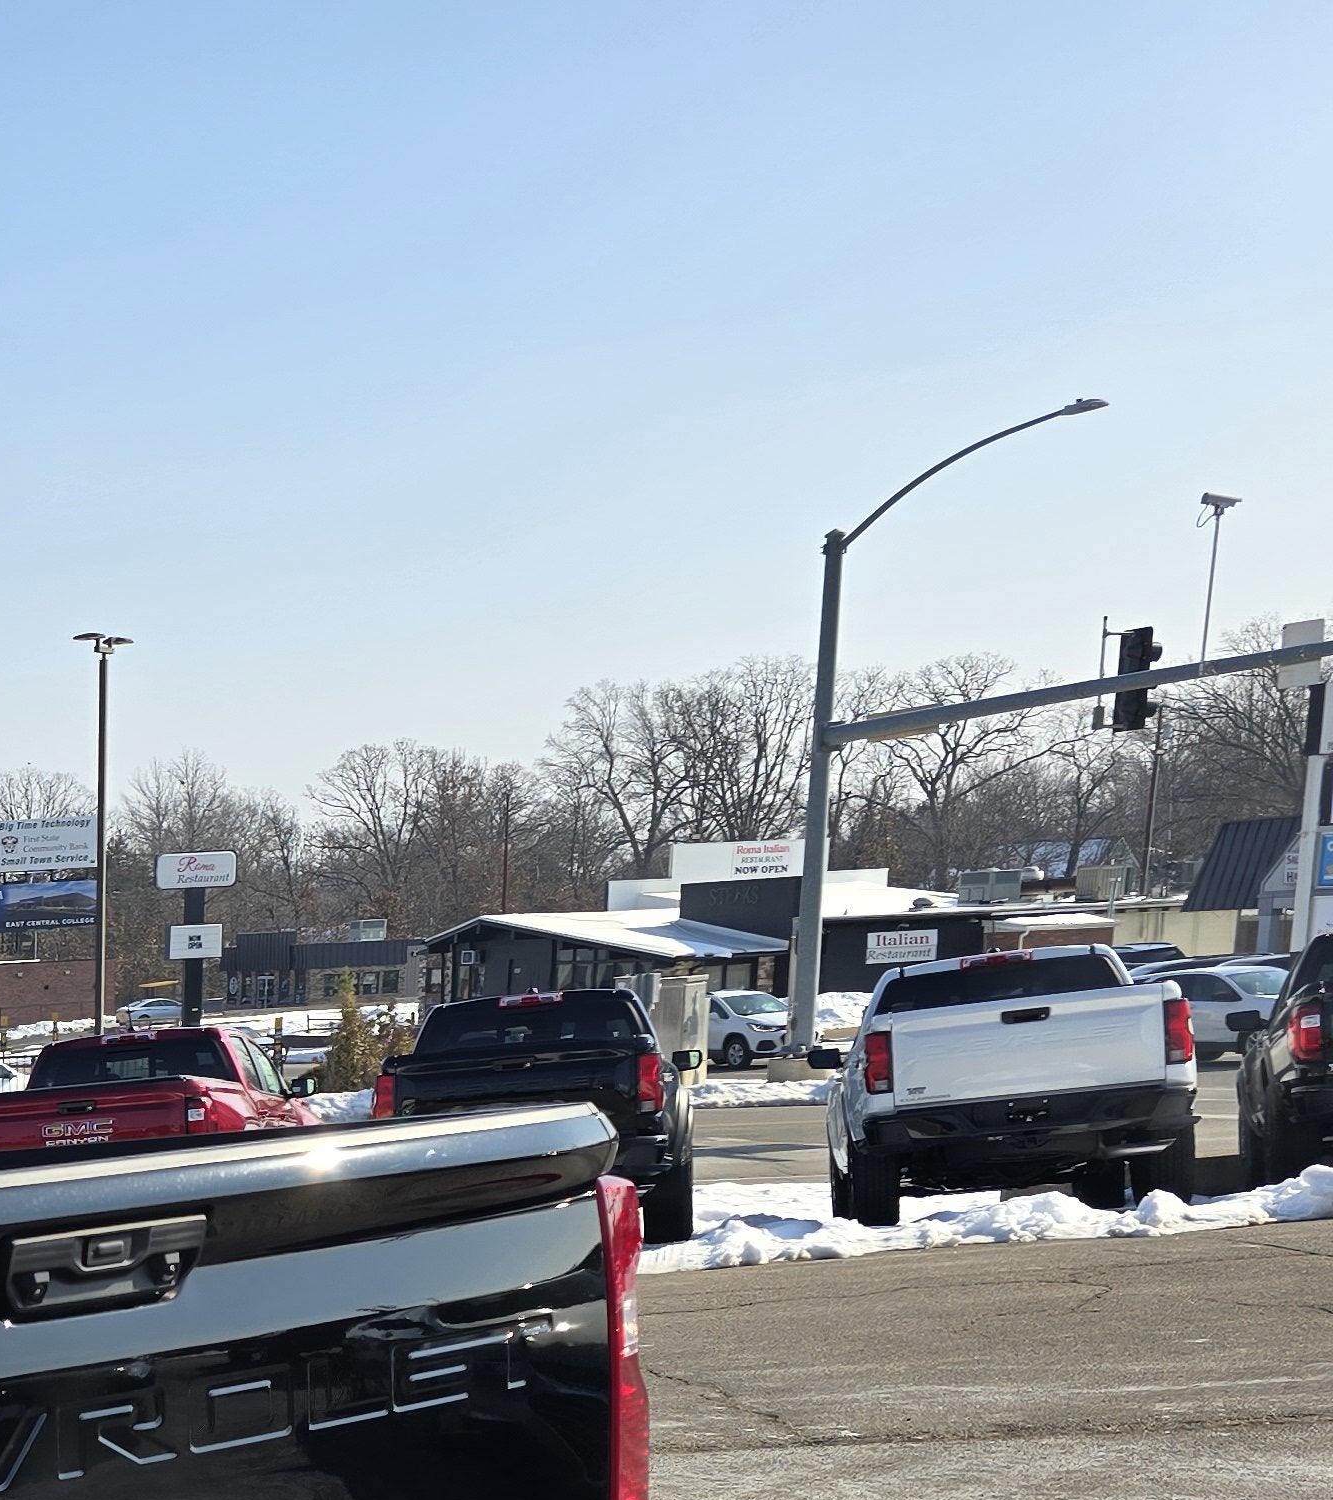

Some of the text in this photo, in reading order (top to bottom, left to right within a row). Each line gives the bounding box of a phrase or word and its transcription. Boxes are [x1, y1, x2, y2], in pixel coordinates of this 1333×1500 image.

[0, 819, 91, 832] Big Time Technology
[23, 835, 40, 843] First
[23, 842, 89, 853] Community Bank
[736, 844, 790, 855] Roma Italian
[1, 854, 89, 866] Small Town Service
[741, 855, 784, 864] RESTAURANT
[734, 864, 789, 875] NOW OPEN
[177, 873, 230, 884] Restaurant
[5, 917, 95, 928] EAST CENTRAL COLLEGE
[876, 934, 930, 947] Italian
[867, 948, 932, 960] Restaurant
[41, 1119, 114, 1138] GMC
[45, 1135, 109, 1147] CANYON
